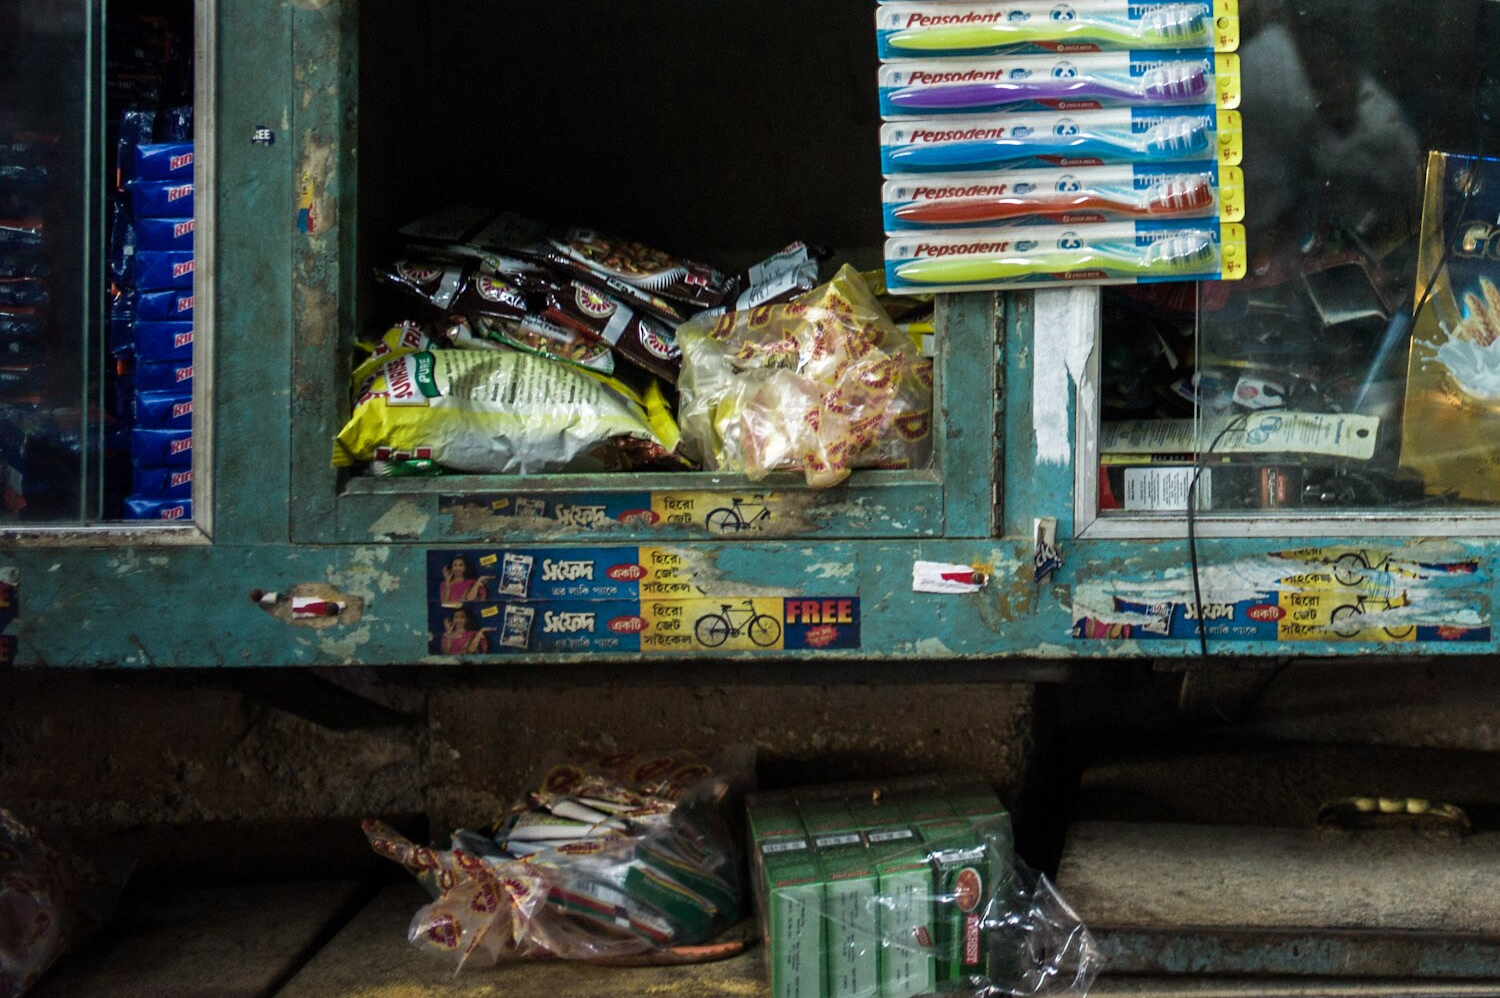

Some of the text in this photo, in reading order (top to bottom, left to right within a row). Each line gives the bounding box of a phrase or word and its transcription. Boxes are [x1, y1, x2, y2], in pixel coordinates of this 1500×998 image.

[910, 127, 1005, 144] Pepsodent
[913, 240, 1009, 258] Pepsodent
[388, 353, 413, 401] SUNRISE
[417, 353, 430, 385] PURE
[787, 601, 853, 624] FREE
[966, 913, 979, 964] EVEREST
